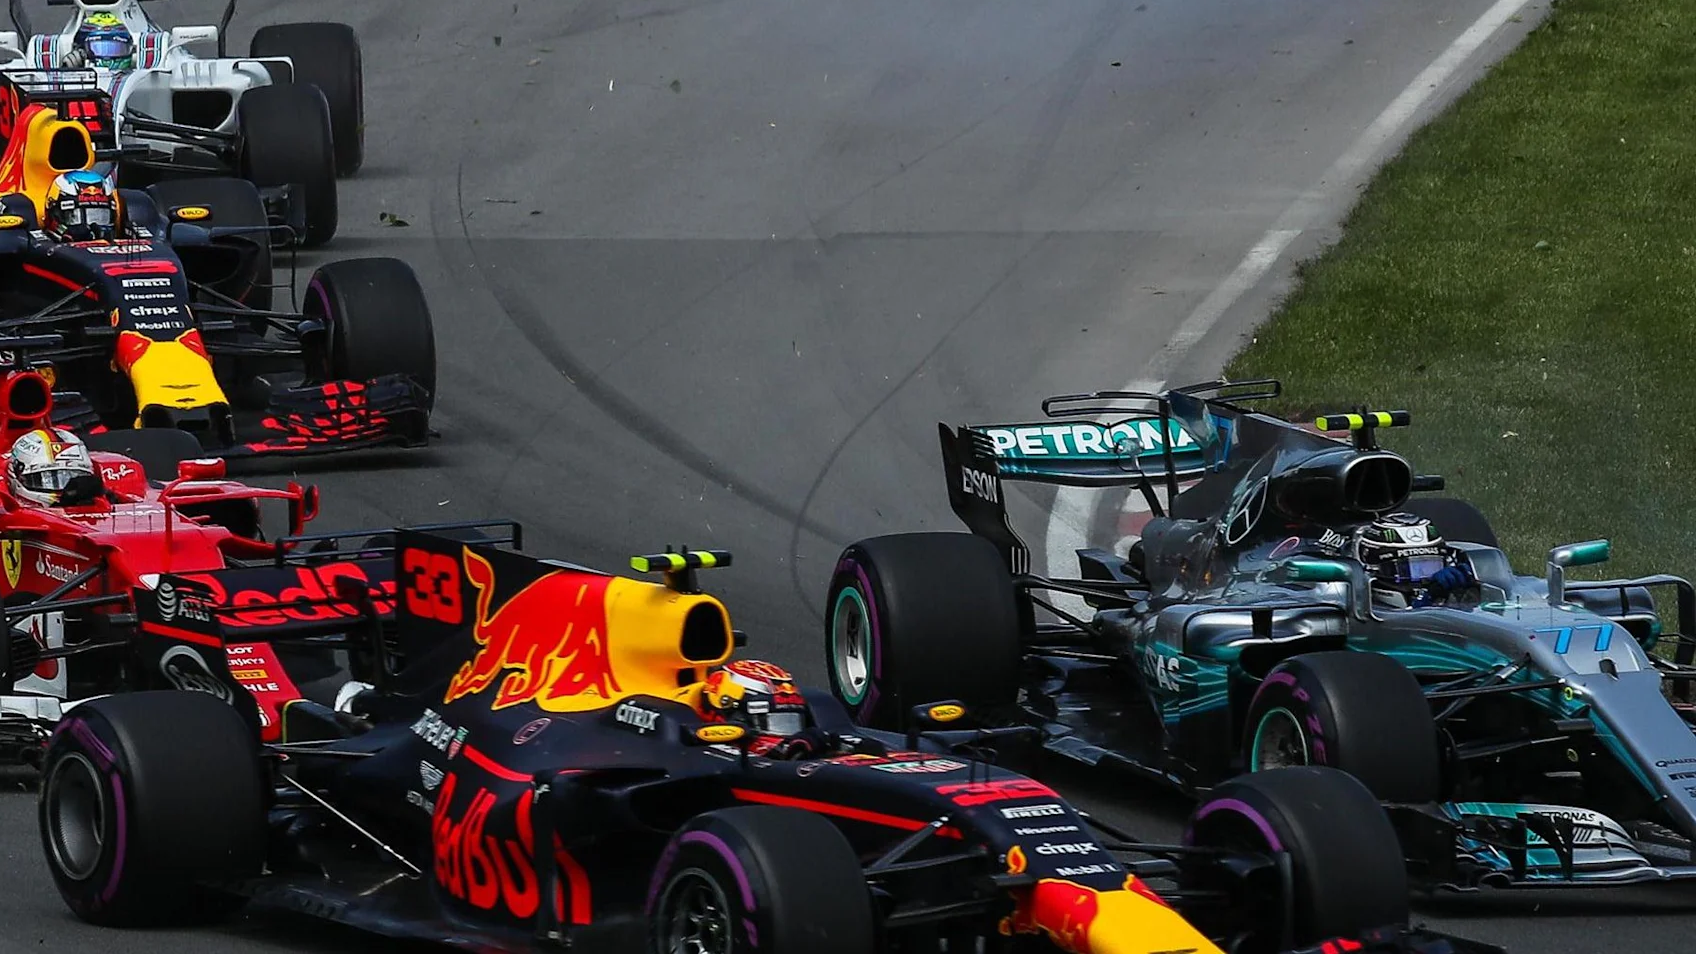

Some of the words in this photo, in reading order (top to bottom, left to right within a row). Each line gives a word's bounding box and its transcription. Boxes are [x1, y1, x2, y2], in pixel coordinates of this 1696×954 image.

[121, 278, 171, 287] PIRELLI
[135, 322, 170, 330] Mobil
[989, 421, 1195, 455] PETRONA
[963, 466, 998, 504] EPSON
[1397, 548, 1439, 557] PETRONAS
[45, 554, 88, 590] Santand
[404, 548, 462, 625] 33
[1533, 624, 1614, 654] 77
[244, 683, 279, 691] HLE
[1000, 804, 1065, 819] PIRELLI
[1014, 824, 1079, 836] Hisense
[1056, 864, 1102, 877] Mobil
